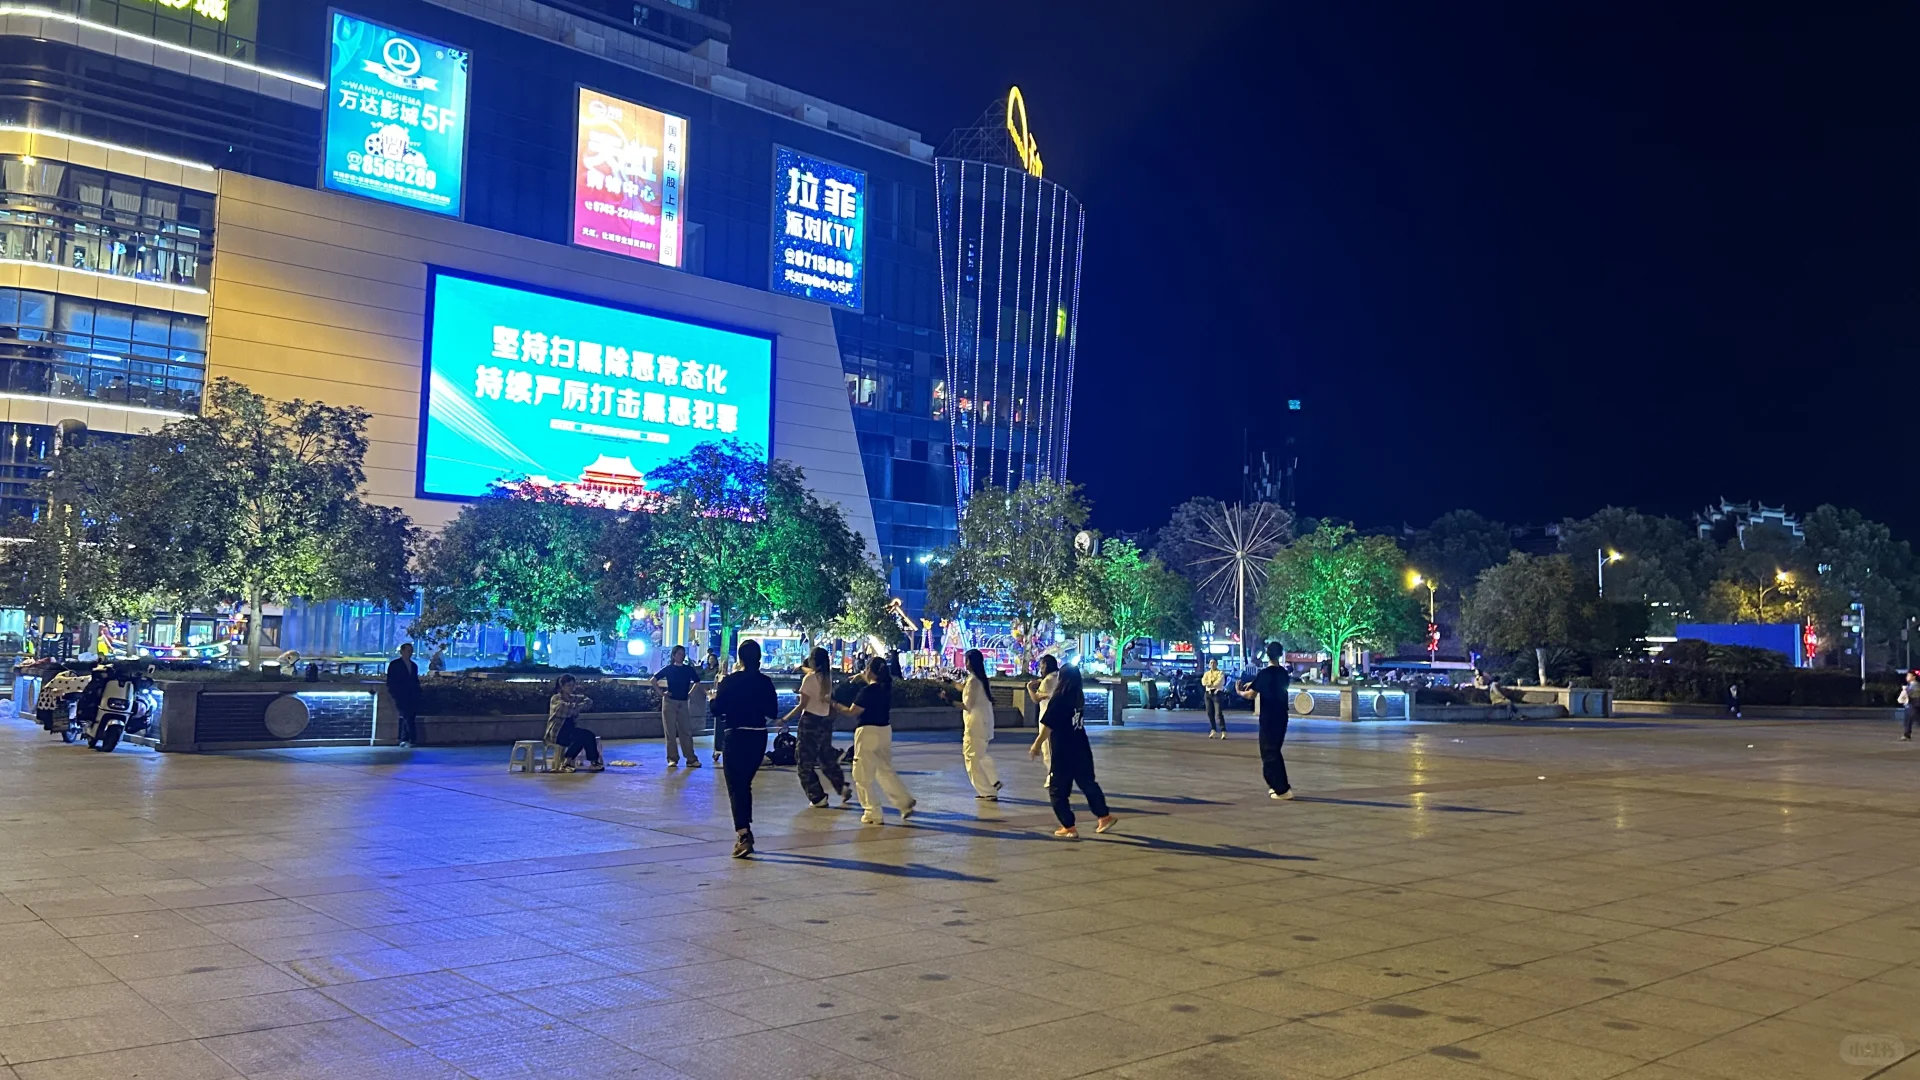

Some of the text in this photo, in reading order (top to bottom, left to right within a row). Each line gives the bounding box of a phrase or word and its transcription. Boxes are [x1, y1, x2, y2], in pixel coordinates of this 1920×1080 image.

[338, 88, 457, 135] 万达影城 5F
[349, 81, 384, 97] WANDA
[361, 154, 437, 190] 8565289
[663, 125, 678, 258] 国有控股上市公司
[787, 166, 857, 219] 拉菲
[785, 209, 855, 251] 派对KTV
[491, 325, 728, 395] 坚持扫黑除恶常态化
[474, 364, 739, 434] 持续严厉打击黑恶犯罪
